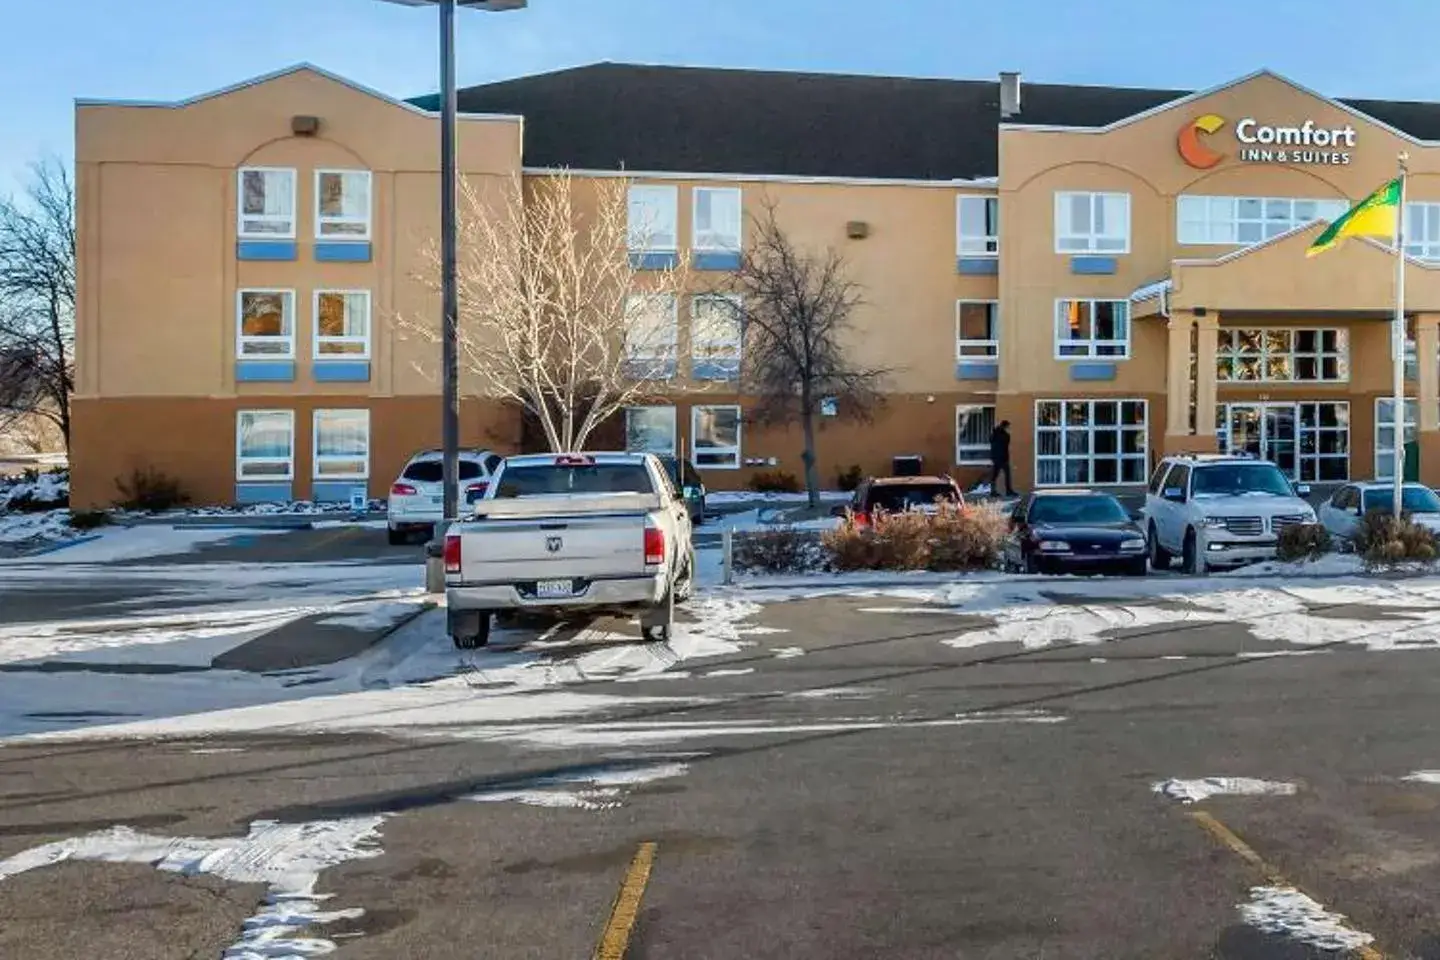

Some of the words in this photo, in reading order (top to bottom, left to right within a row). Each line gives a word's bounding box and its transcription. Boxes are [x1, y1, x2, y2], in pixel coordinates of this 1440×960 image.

[1236, 119, 1356, 147] Comfort
[1241, 149, 1273, 162] INN
[1277, 151, 1288, 163] &
[1293, 151, 1350, 165] SUITES
